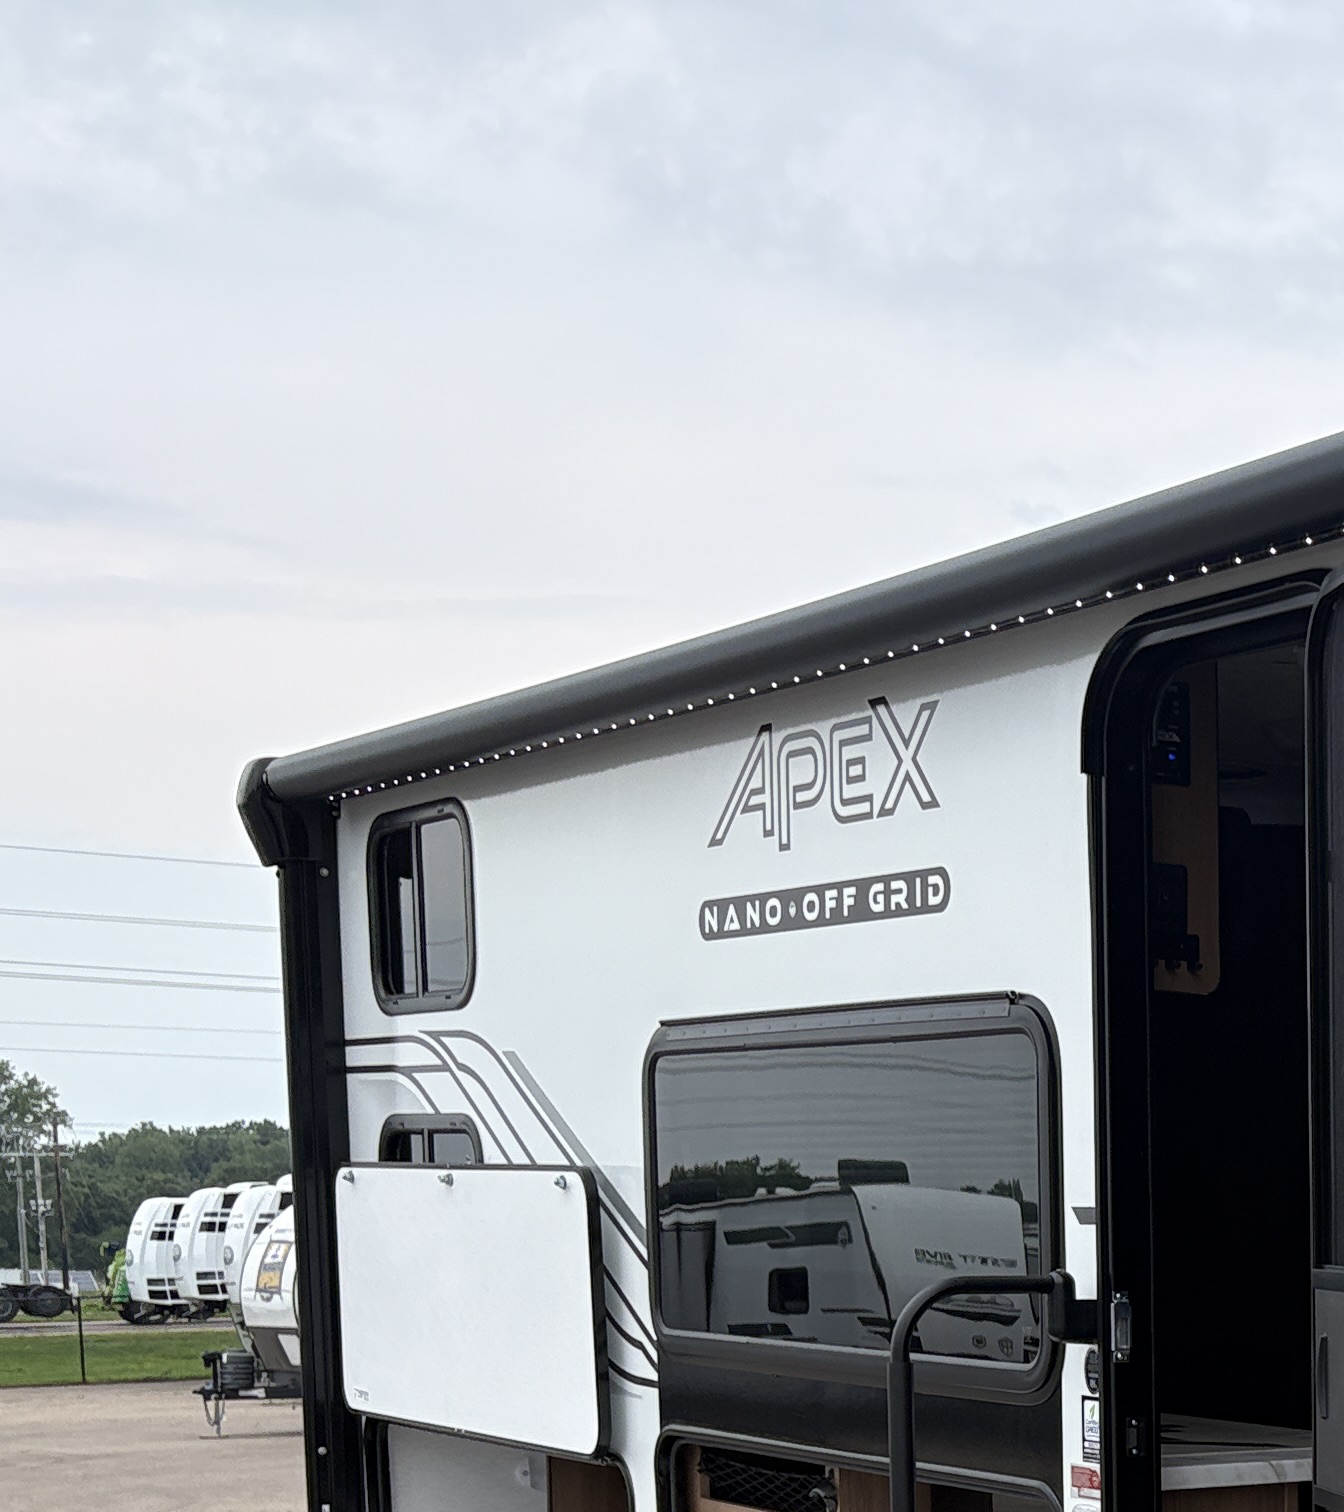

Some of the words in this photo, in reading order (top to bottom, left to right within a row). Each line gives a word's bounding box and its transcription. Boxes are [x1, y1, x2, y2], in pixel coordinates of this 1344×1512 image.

[707, 695, 942, 853] APEX
[704, 897, 782, 934] NANO
[802, 886, 856, 922] OFF
[868, 874, 945, 914] GRID
